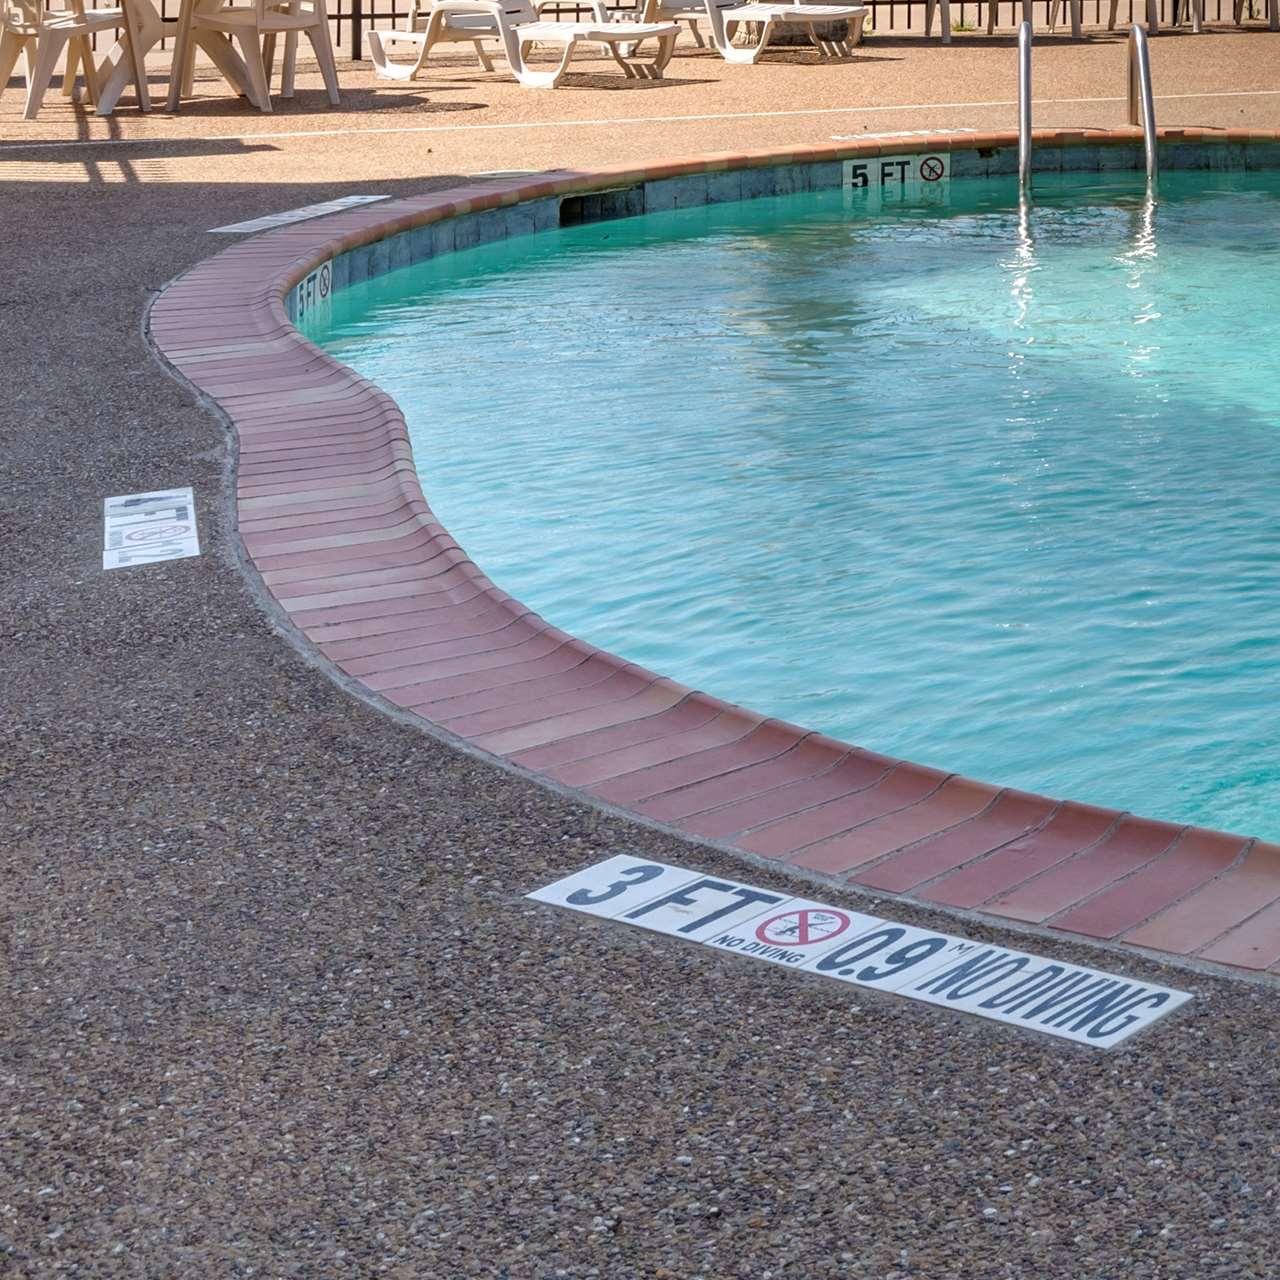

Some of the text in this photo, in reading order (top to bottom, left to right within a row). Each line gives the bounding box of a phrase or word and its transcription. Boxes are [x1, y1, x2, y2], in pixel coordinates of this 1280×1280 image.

[852, 161, 910, 188] 5 FT
[566, 865, 665, 906] 3
[629, 880, 778, 934] FT
[816, 927, 948, 981] 0.9
[914, 950, 1032, 1001] NO
[978, 965, 1171, 1039] DIVING
[713, 934, 805, 964] NO DIVING
